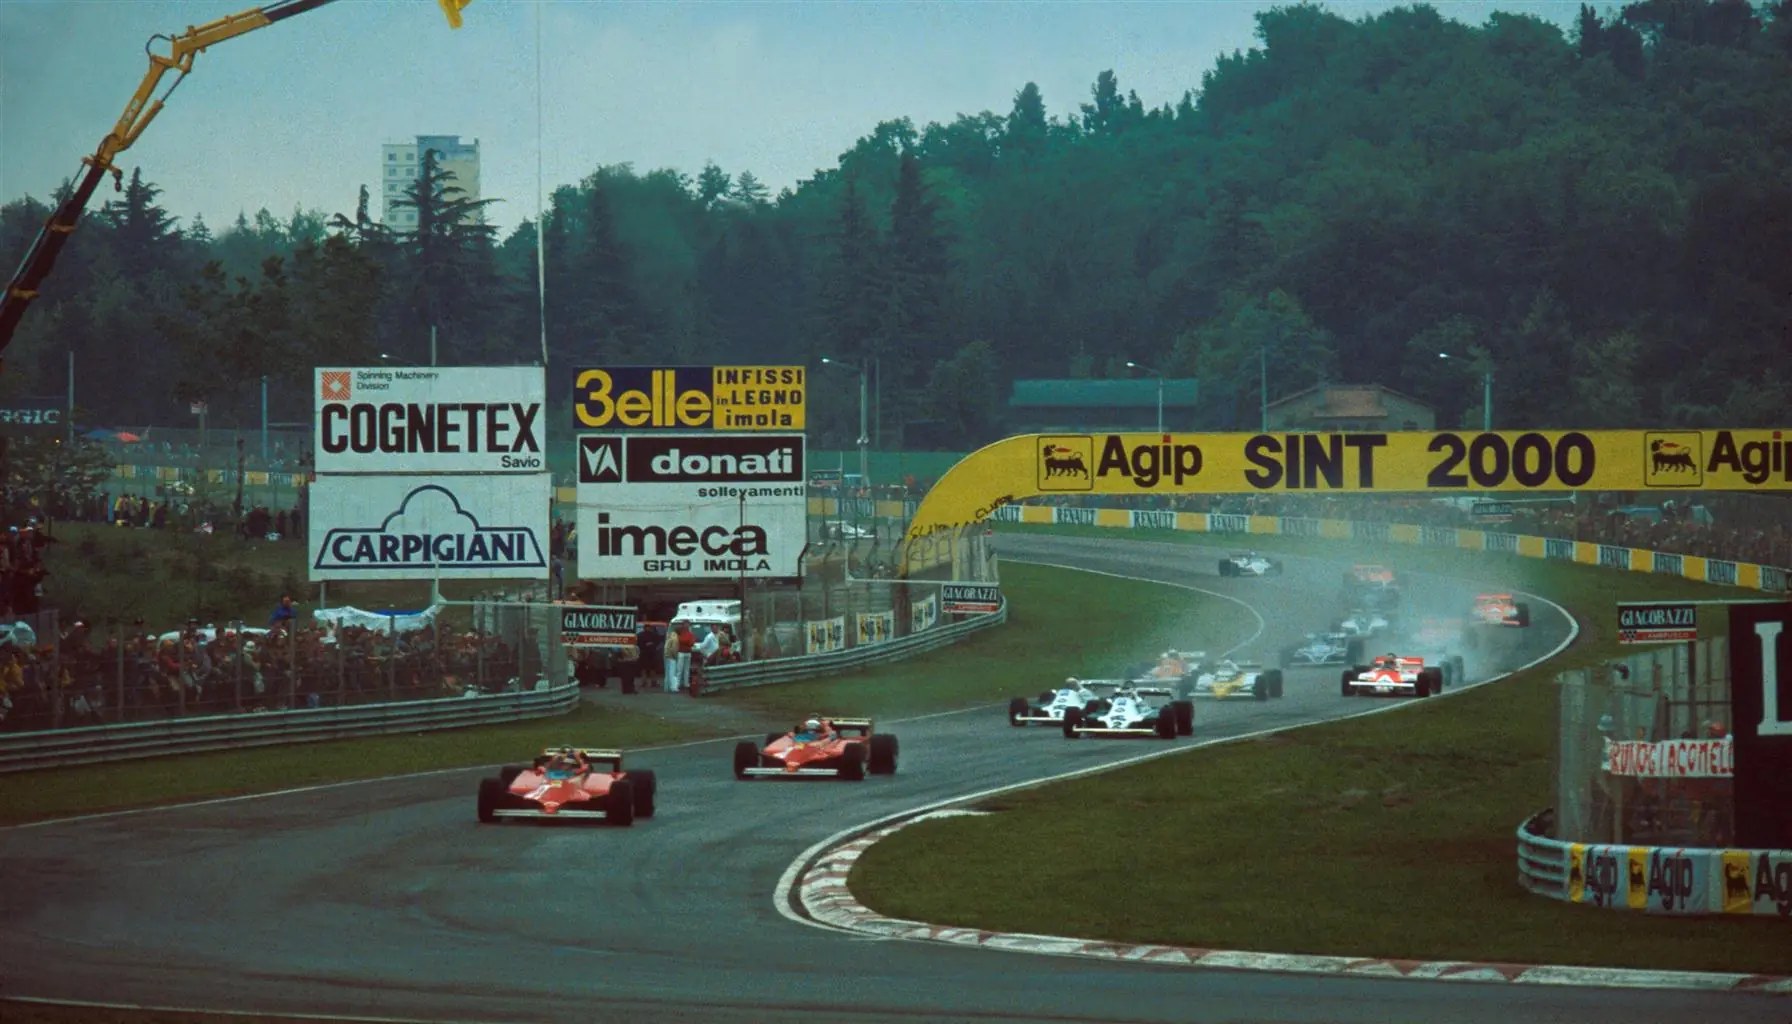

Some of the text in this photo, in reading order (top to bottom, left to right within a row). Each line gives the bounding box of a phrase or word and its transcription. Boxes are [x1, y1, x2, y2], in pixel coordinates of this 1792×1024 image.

[356, 371, 439, 381] Spinning Machinery
[717, 369, 803, 385] INFISSI
[356, 382, 389, 390] Division
[575, 369, 712, 427] 3elle
[717, 390, 803, 405] in LEGNO
[726, 409, 792, 426] imola
[321, 403, 541, 454] COGNETEX
[501, 455, 540, 468] Savio
[651, 448, 793, 475] donati
[1097, 432, 1596, 488] Agip SINT 2000
[698, 486, 804, 497] sollevamenti
[598, 513, 769, 556] imeca
[332, 533, 526, 563] CARPIGIANI
[643, 559, 771, 571] GRU IMOLA
[564, 612, 635, 629] GIACOBAZZI
[1621, 608, 1694, 626] GIACOBAZZI
[1649, 848, 1693, 910] Agip
